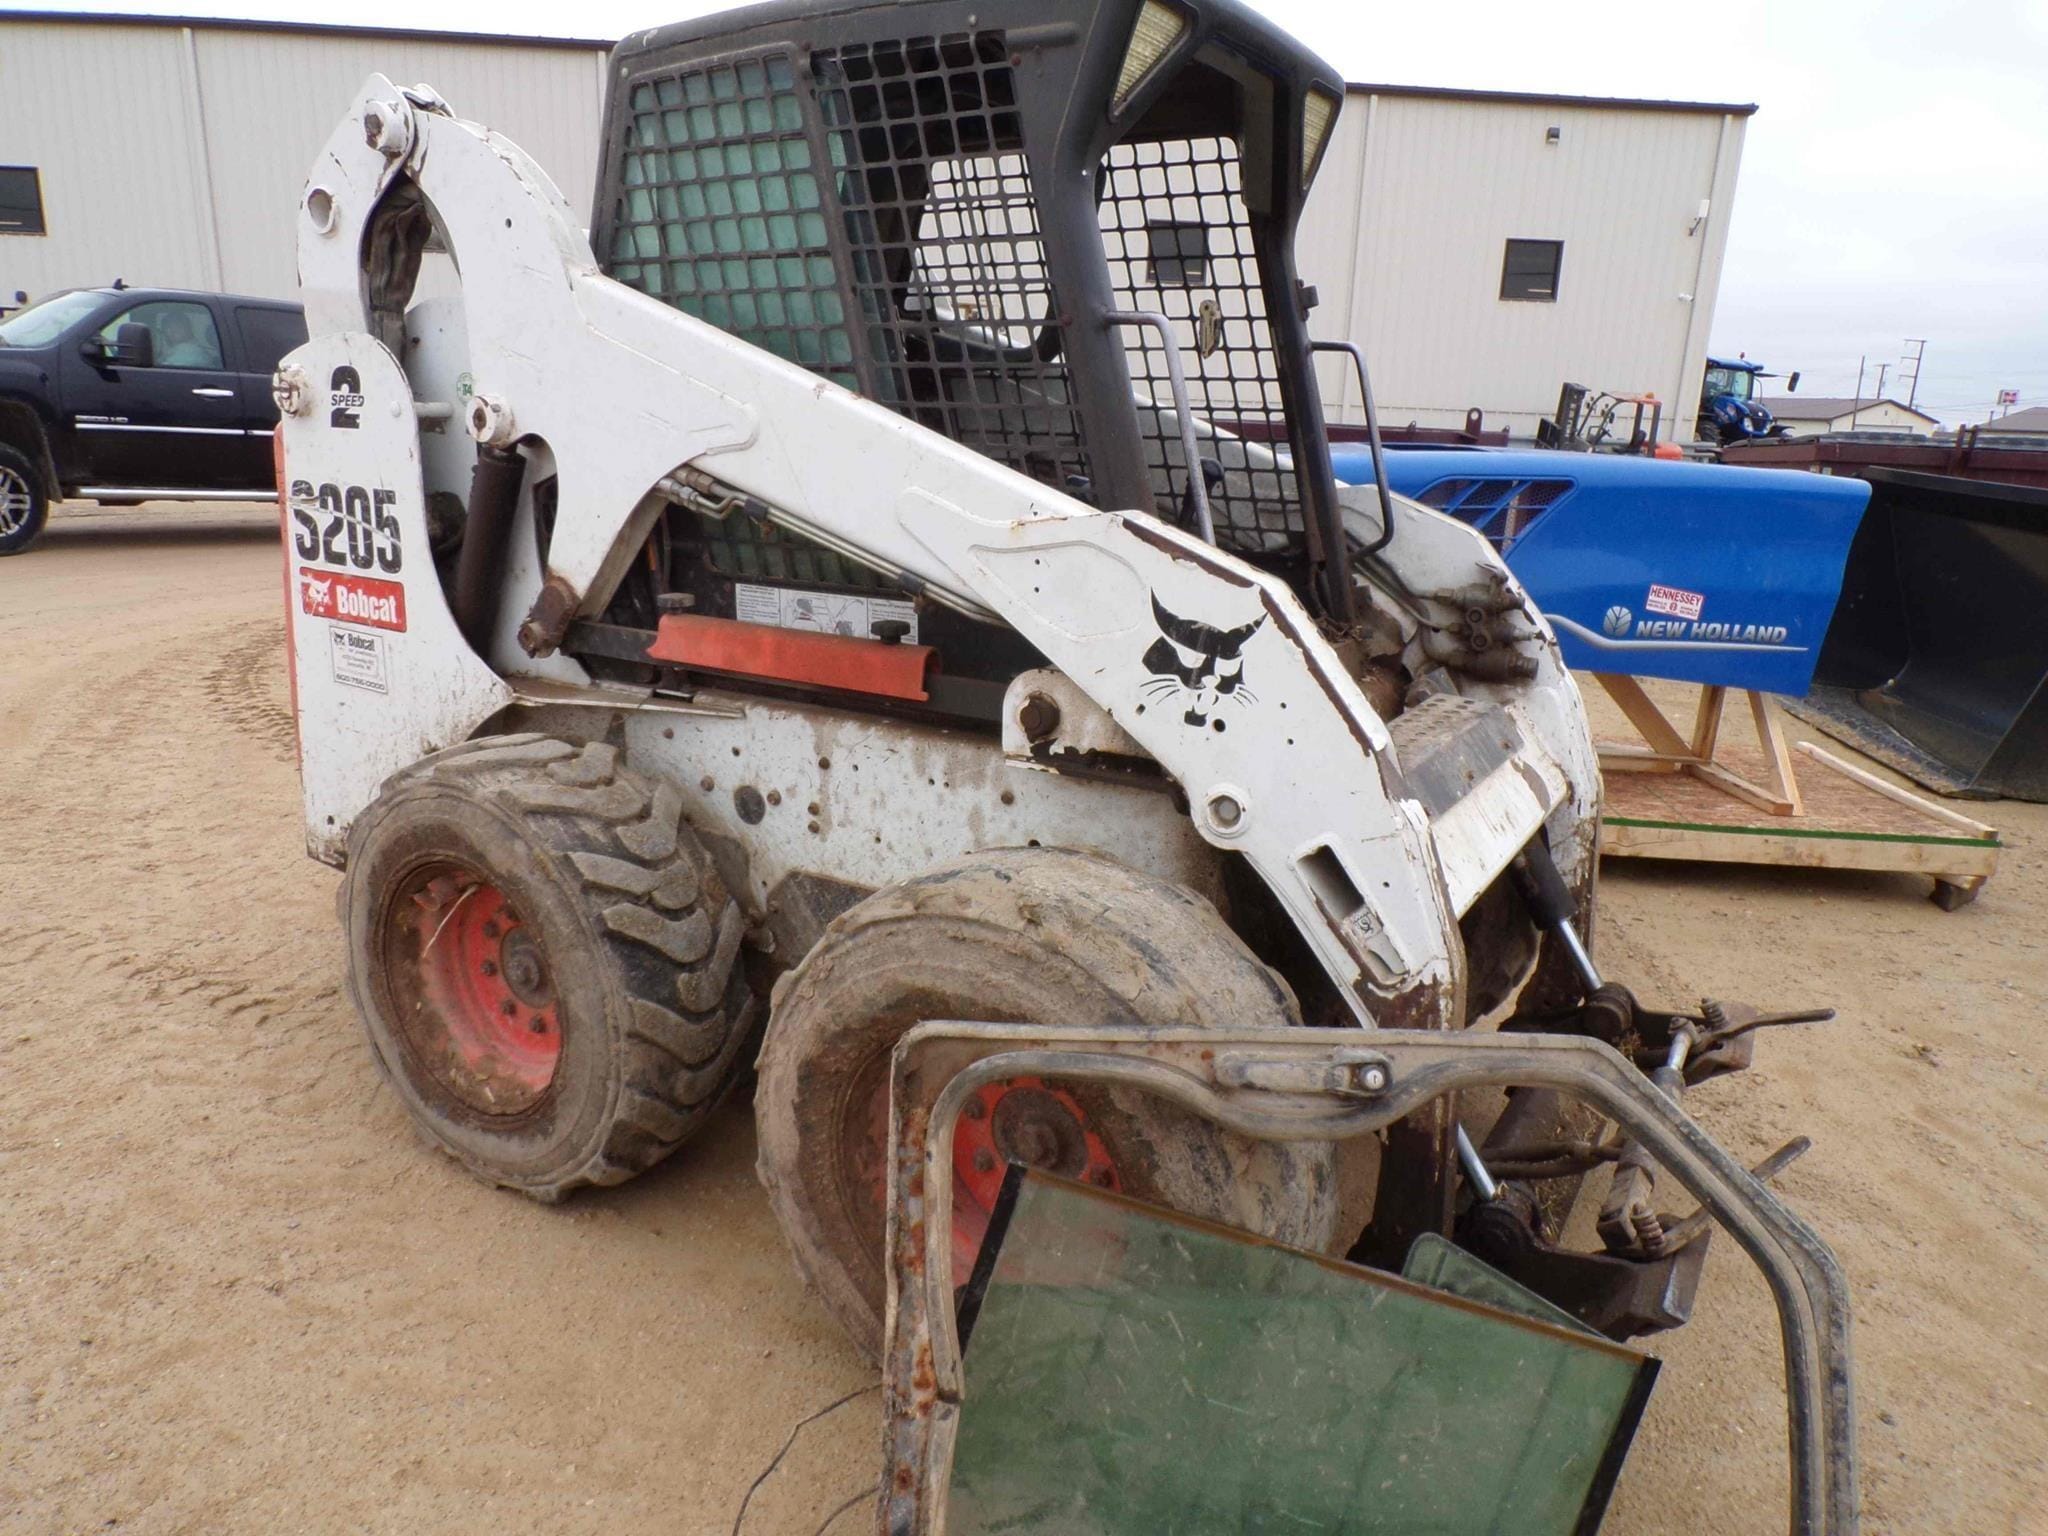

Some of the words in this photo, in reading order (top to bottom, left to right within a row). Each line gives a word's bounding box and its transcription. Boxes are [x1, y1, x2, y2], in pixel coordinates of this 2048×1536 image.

[331, 366, 361, 429] 2
[331, 394, 365, 407] SPEED
[292, 480, 402, 574] S205
[336, 585, 397, 623] Bobcat
[1650, 587, 1701, 606] HENNESSEY
[348, 633, 375, 651] Bobcat
[1636, 621, 1687, 638] NEW
[1690, 622, 1787, 643] HOLLAND
